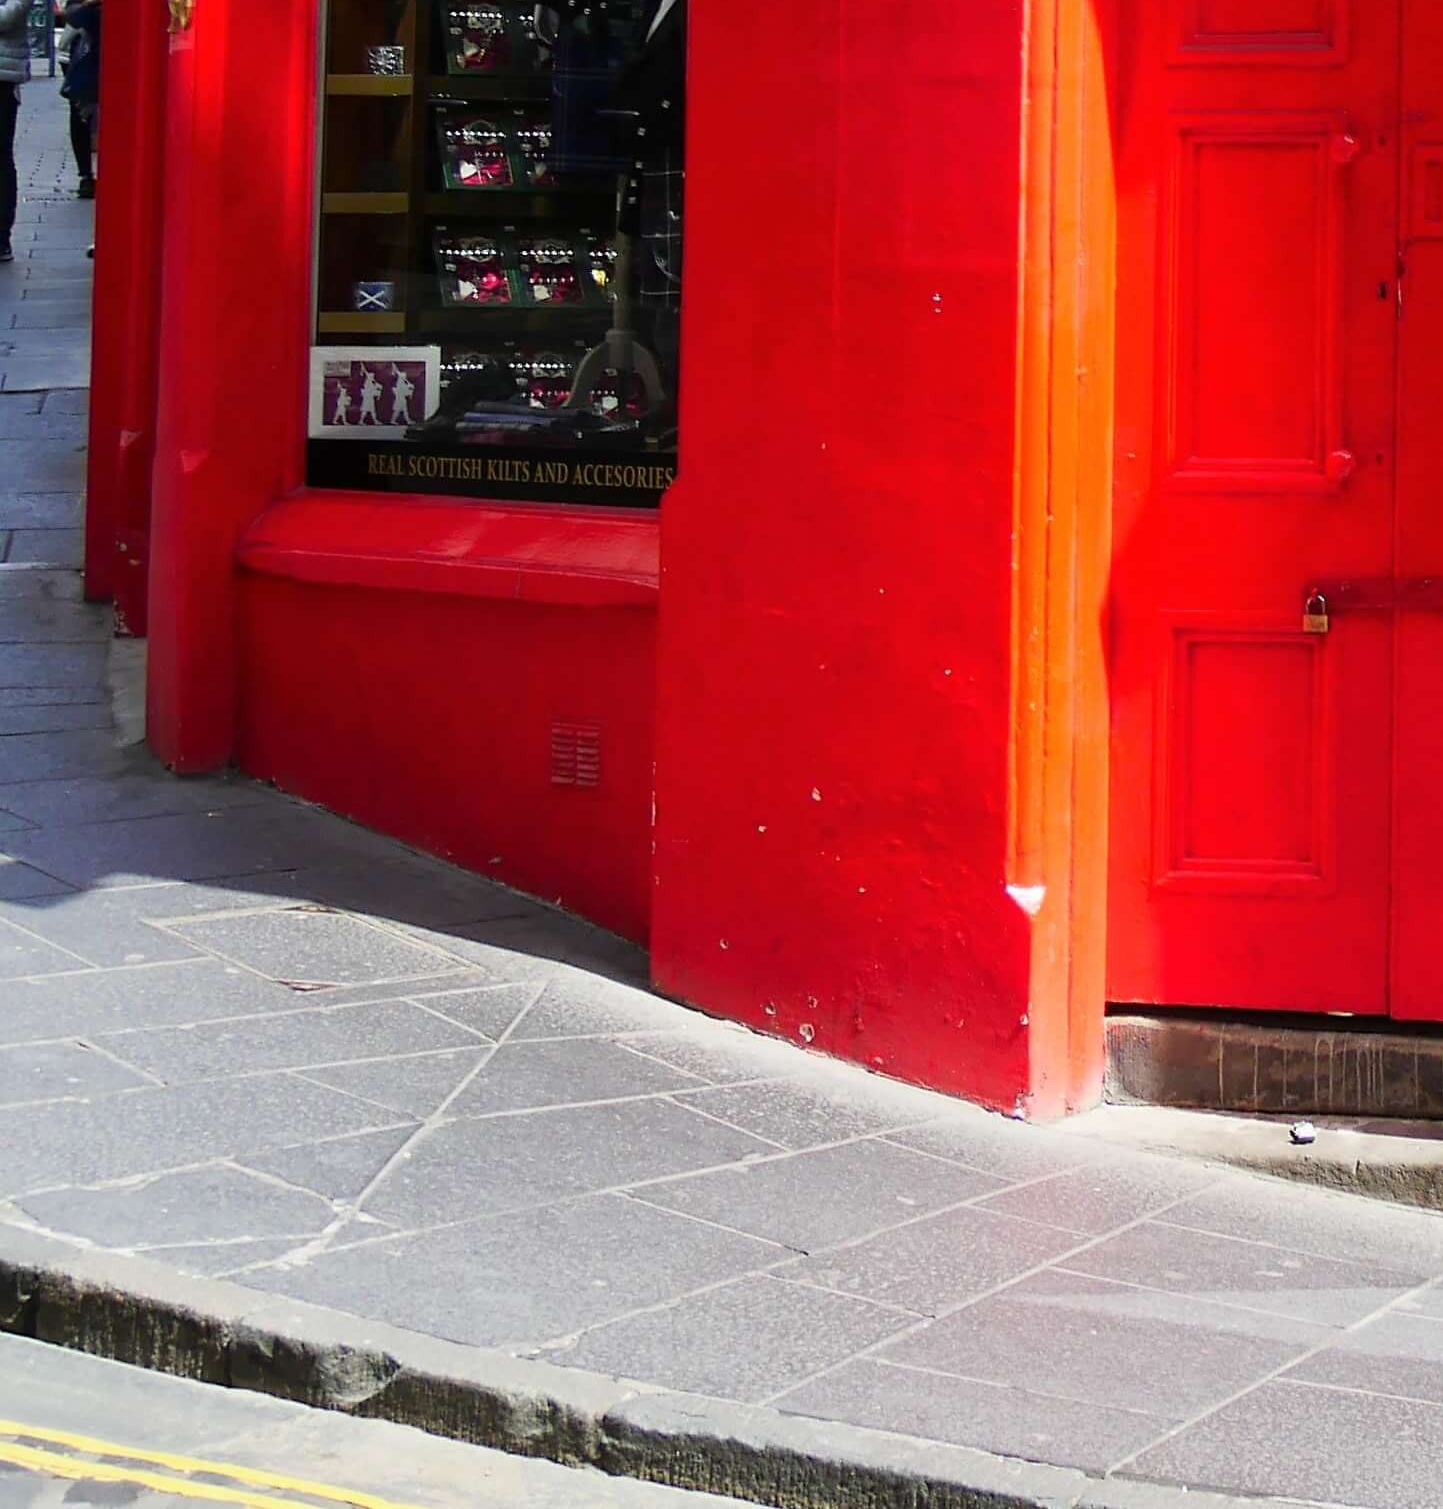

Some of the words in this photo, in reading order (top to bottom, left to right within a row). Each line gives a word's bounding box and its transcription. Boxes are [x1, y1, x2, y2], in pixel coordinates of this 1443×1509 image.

[368, 454, 402, 475] REAL
[408, 455, 483, 480] SCOTTISH
[487, 458, 530, 483] KILTS
[534, 461, 569, 484] AND
[572, 463, 674, 490] ACCESORIES
